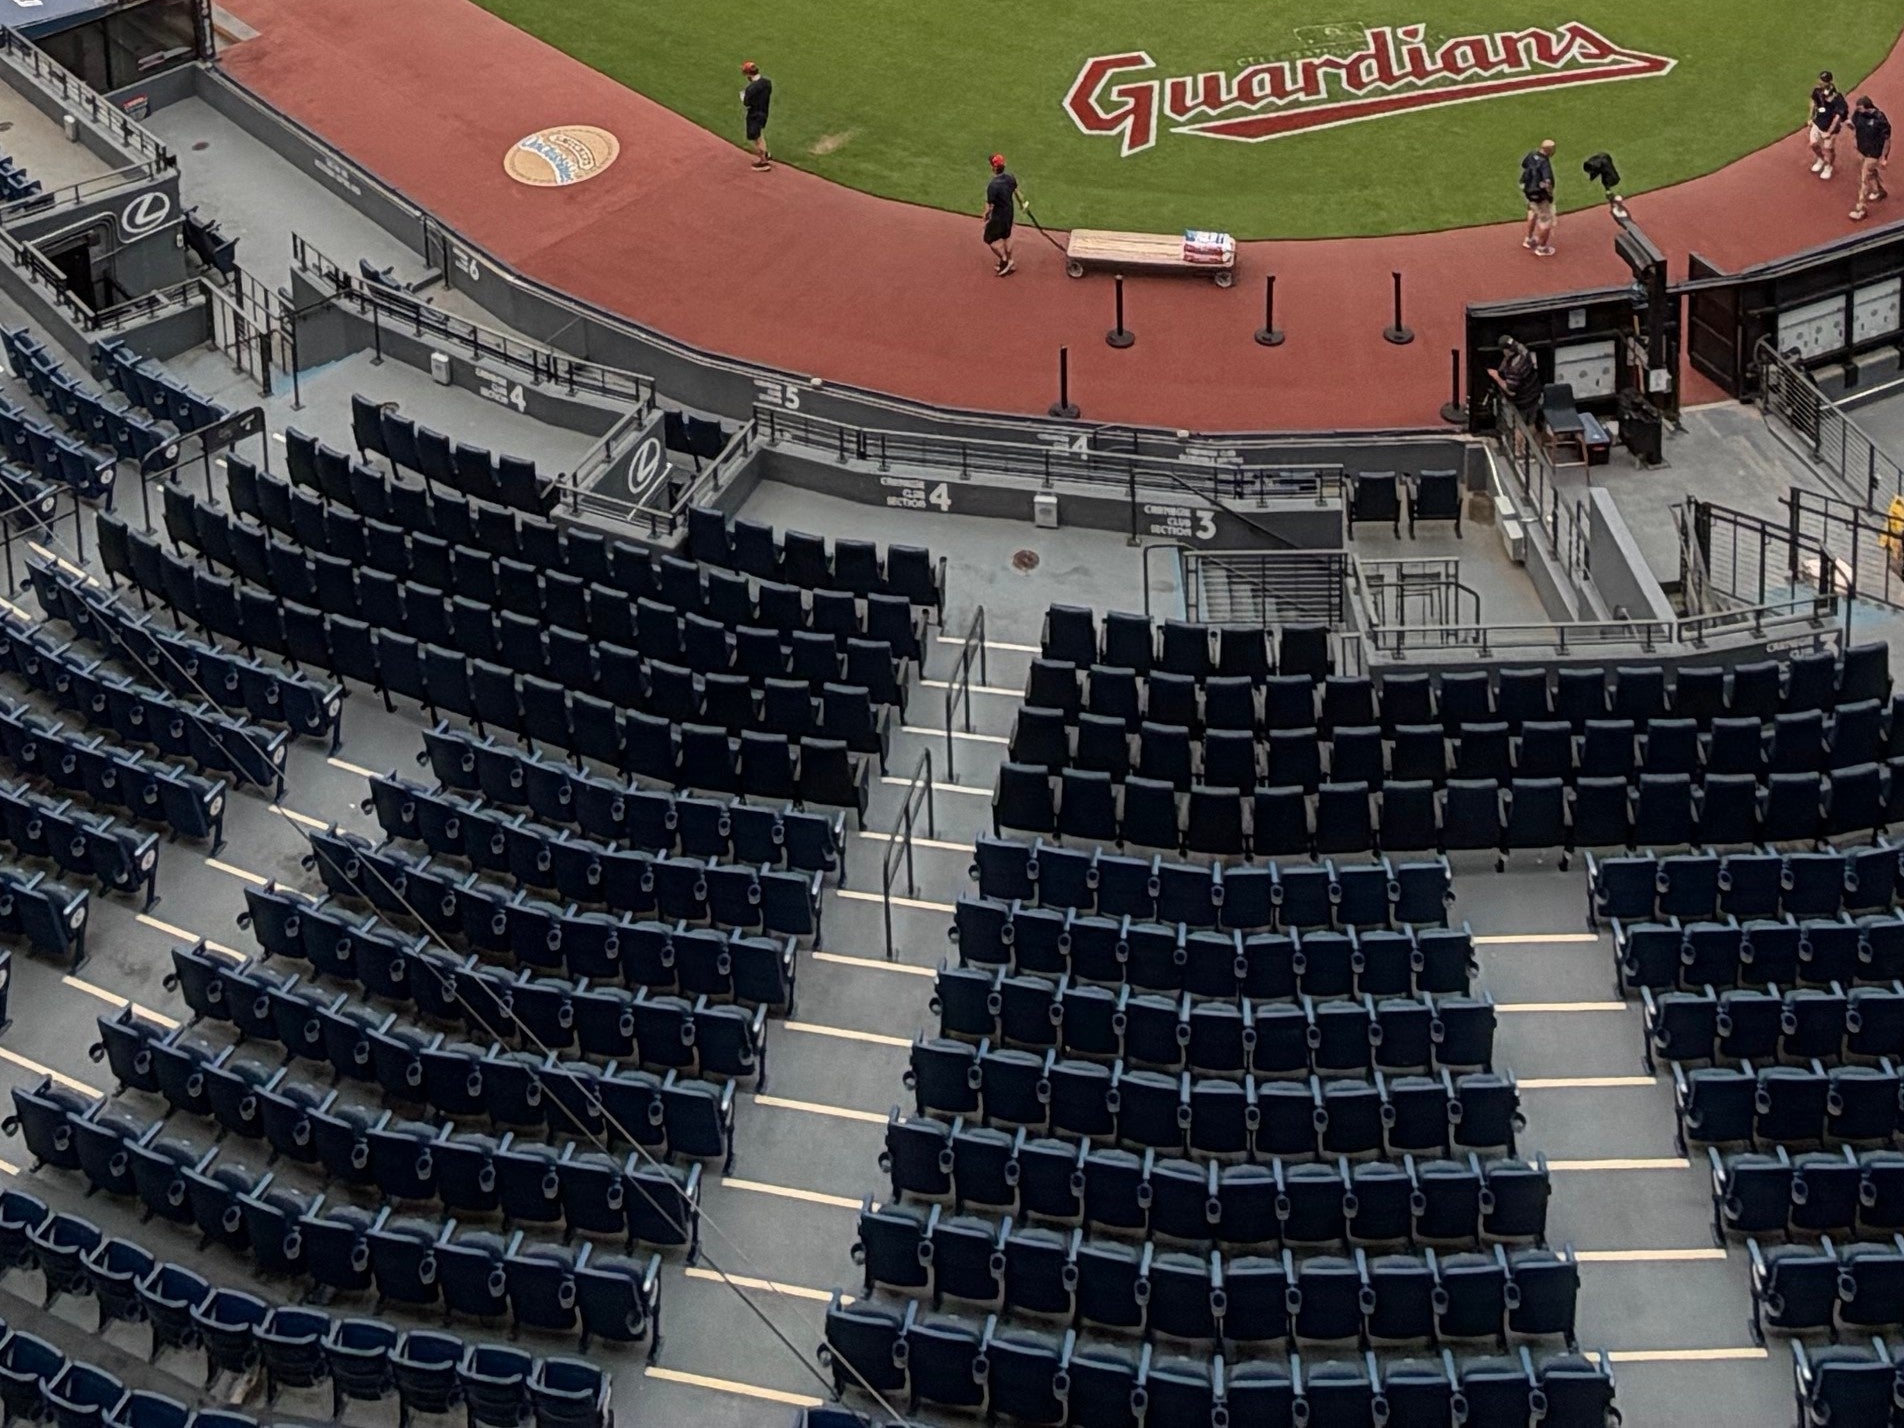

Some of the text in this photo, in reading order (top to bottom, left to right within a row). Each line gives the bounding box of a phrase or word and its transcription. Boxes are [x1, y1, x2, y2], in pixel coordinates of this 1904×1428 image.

[1062, 21, 1678, 157] Guardians
[509, 384, 527, 413] 4
[784, 385, 801, 410] 5
[929, 482, 952, 512] 4
[1195, 510, 1217, 541] 3
